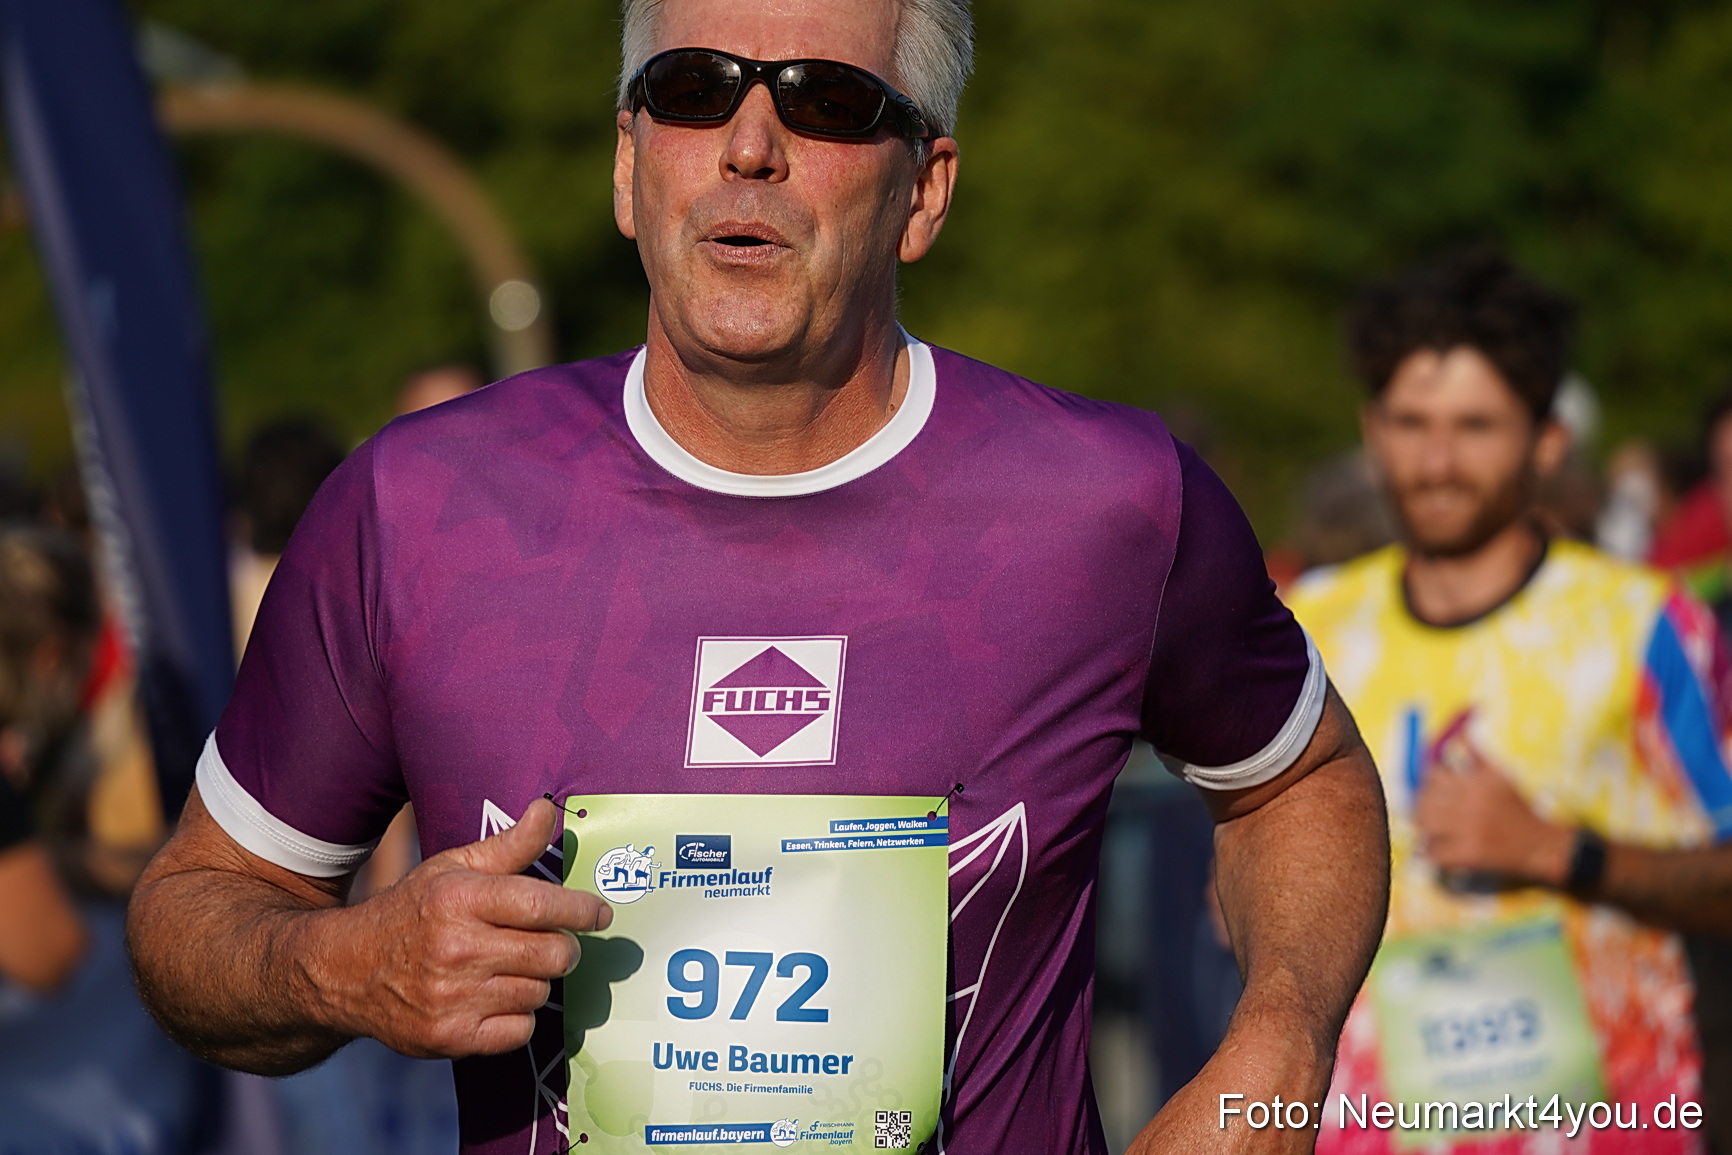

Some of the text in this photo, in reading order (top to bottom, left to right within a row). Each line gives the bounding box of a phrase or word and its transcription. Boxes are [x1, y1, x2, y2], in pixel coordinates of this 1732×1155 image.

[702, 690, 831, 712] FUCHS
[834, 820, 928, 832] Laufen, Joggen, Walken
[786, 837, 925, 851] Essen, Trinken, Feiern, Netzwerken
[687, 848, 728, 858] Fischer
[659, 866, 774, 889] Firmenlauf
[704, 884, 771, 899] neumarkt
[666, 948, 830, 1023] 972
[652, 1042, 854, 1075] Uwe Baumer
[689, 1081, 813, 1094] FUCHS. Die Firmenfamilie
[651, 1128, 765, 1145] firmenlauf.bayern
[800, 1129, 855, 1140] Firmenlauf
